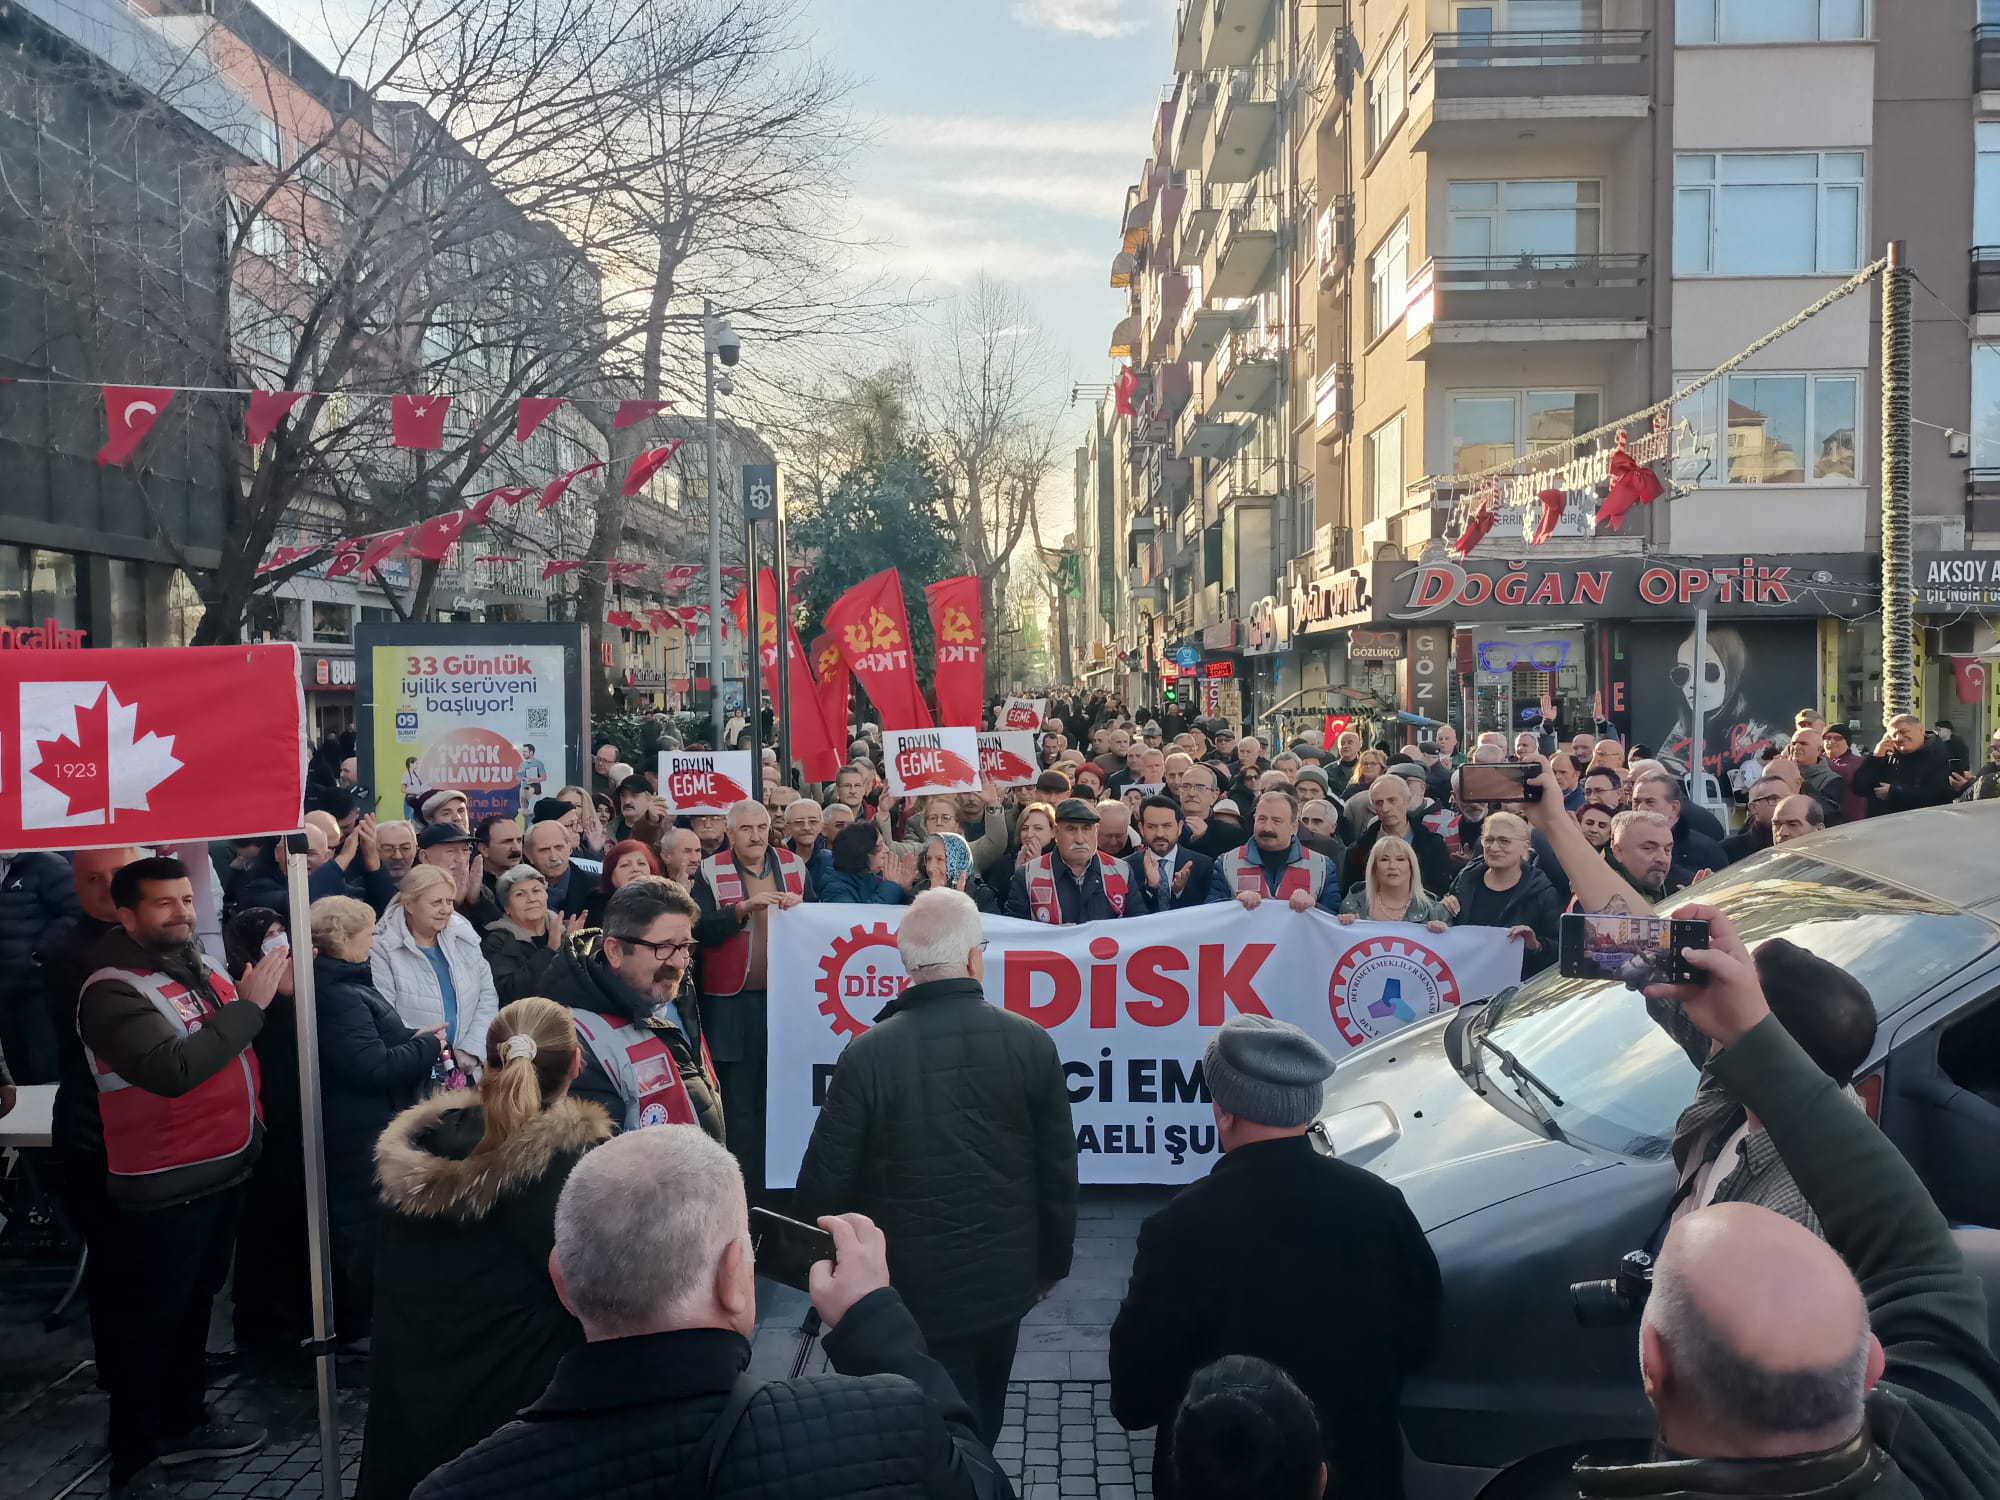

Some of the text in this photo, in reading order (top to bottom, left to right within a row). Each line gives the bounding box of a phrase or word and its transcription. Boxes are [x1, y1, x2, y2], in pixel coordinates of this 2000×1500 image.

[1818, 571, 1829, 582] 5
[1928, 561, 1987, 583] AKSOY
[1388, 558, 1792, 620] DOĞAN OPTİK
[1352, 645, 1400, 660] GÖZLÜKÇÜ
[407, 654, 533, 676] 33 Günlük
[402, 676, 538, 698] iyilik serüveni
[426, 696, 514, 716] başlıyor!
[397, 714, 416, 726] 09
[898, 733, 941, 753] BOYUN
[54, 762, 97, 779] 1923
[672, 757, 714, 775] BOYUN
[900, 750, 945, 778] EĞME
[428, 766, 513, 783] KILAVUZU
[844, 964, 913, 997] DİSK
[1004, 936, 1277, 1029] DİSK
